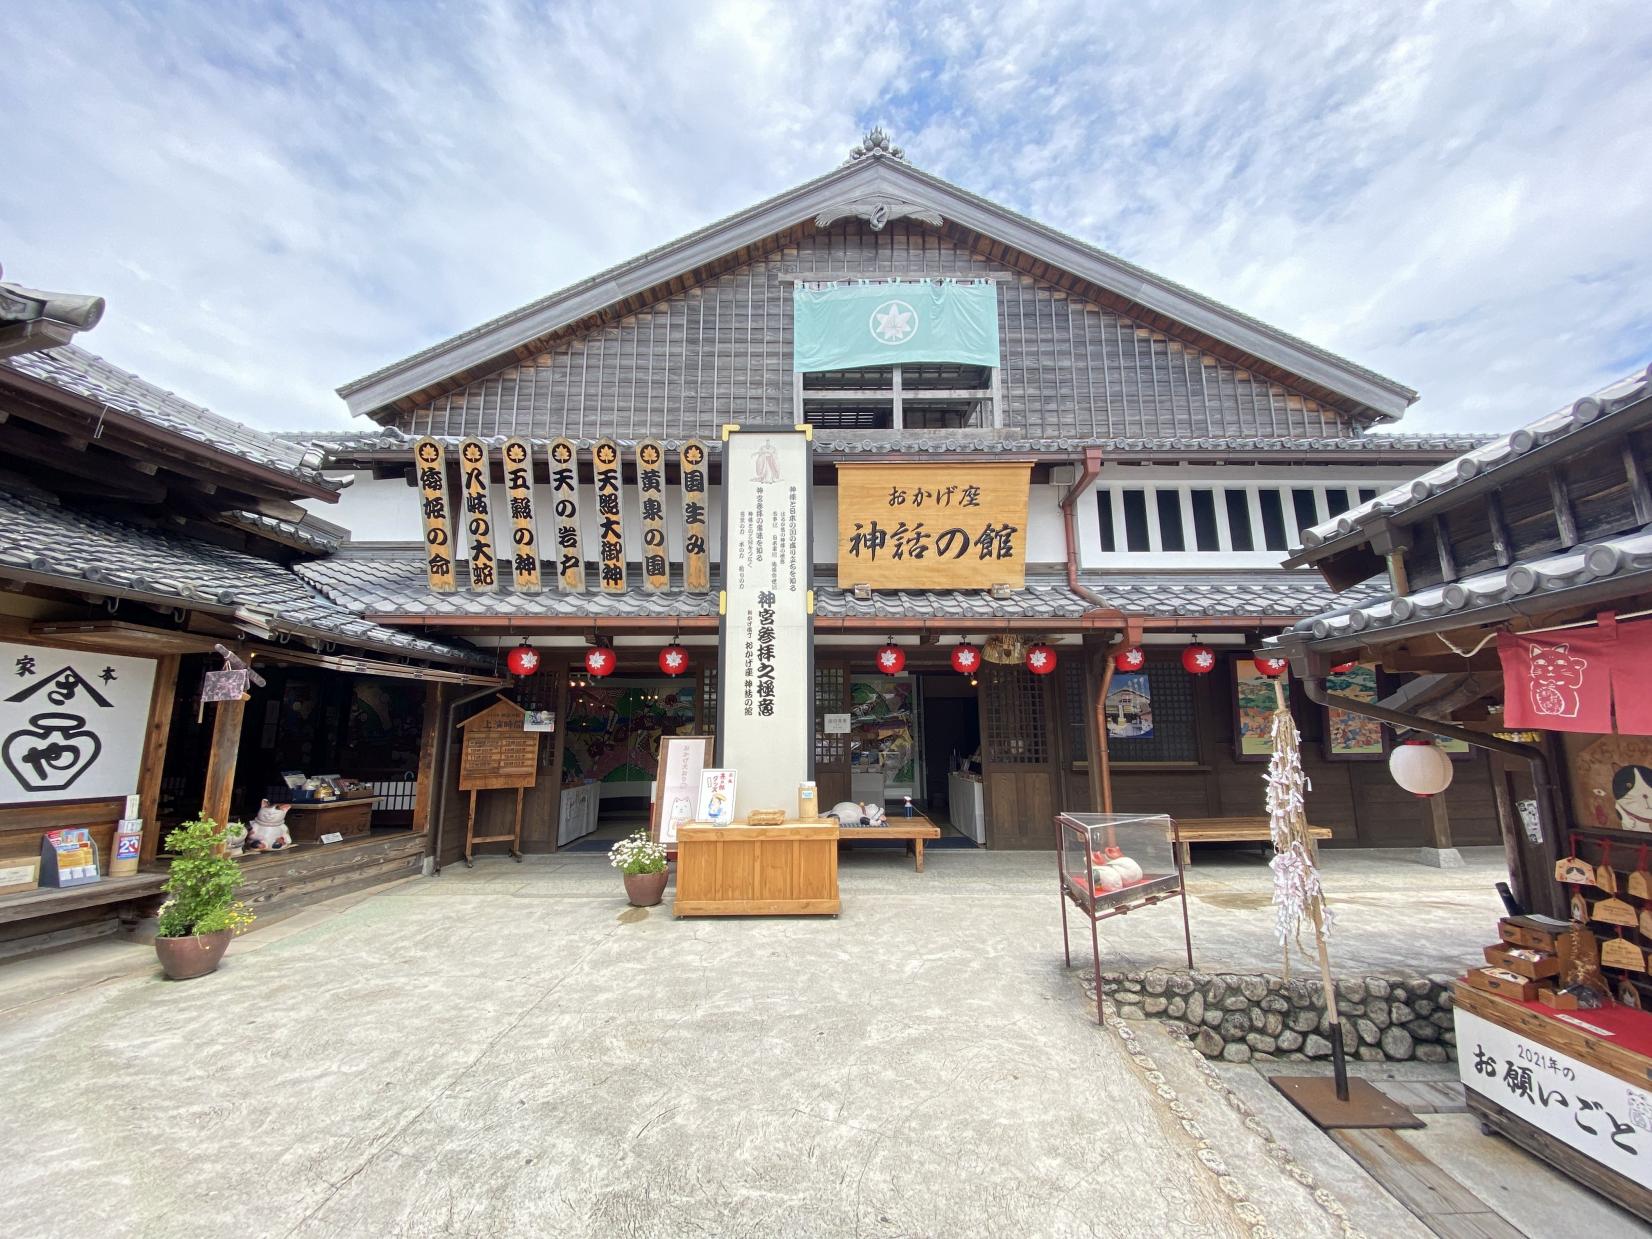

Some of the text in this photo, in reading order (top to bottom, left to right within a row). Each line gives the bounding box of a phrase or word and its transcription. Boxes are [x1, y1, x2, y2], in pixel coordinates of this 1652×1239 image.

[465, 467, 493, 586] 八岐の大蛇
[553, 468, 579, 576] 天の岩戸
[597, 468, 622, 586] 天照大御神
[849, 520, 1018, 562] 神話の館
[888, 485, 981, 508] おかげ座
[1473, 1044, 1638, 1155] お願いごと
[1517, 1044, 1575, 1081] 2021年の
